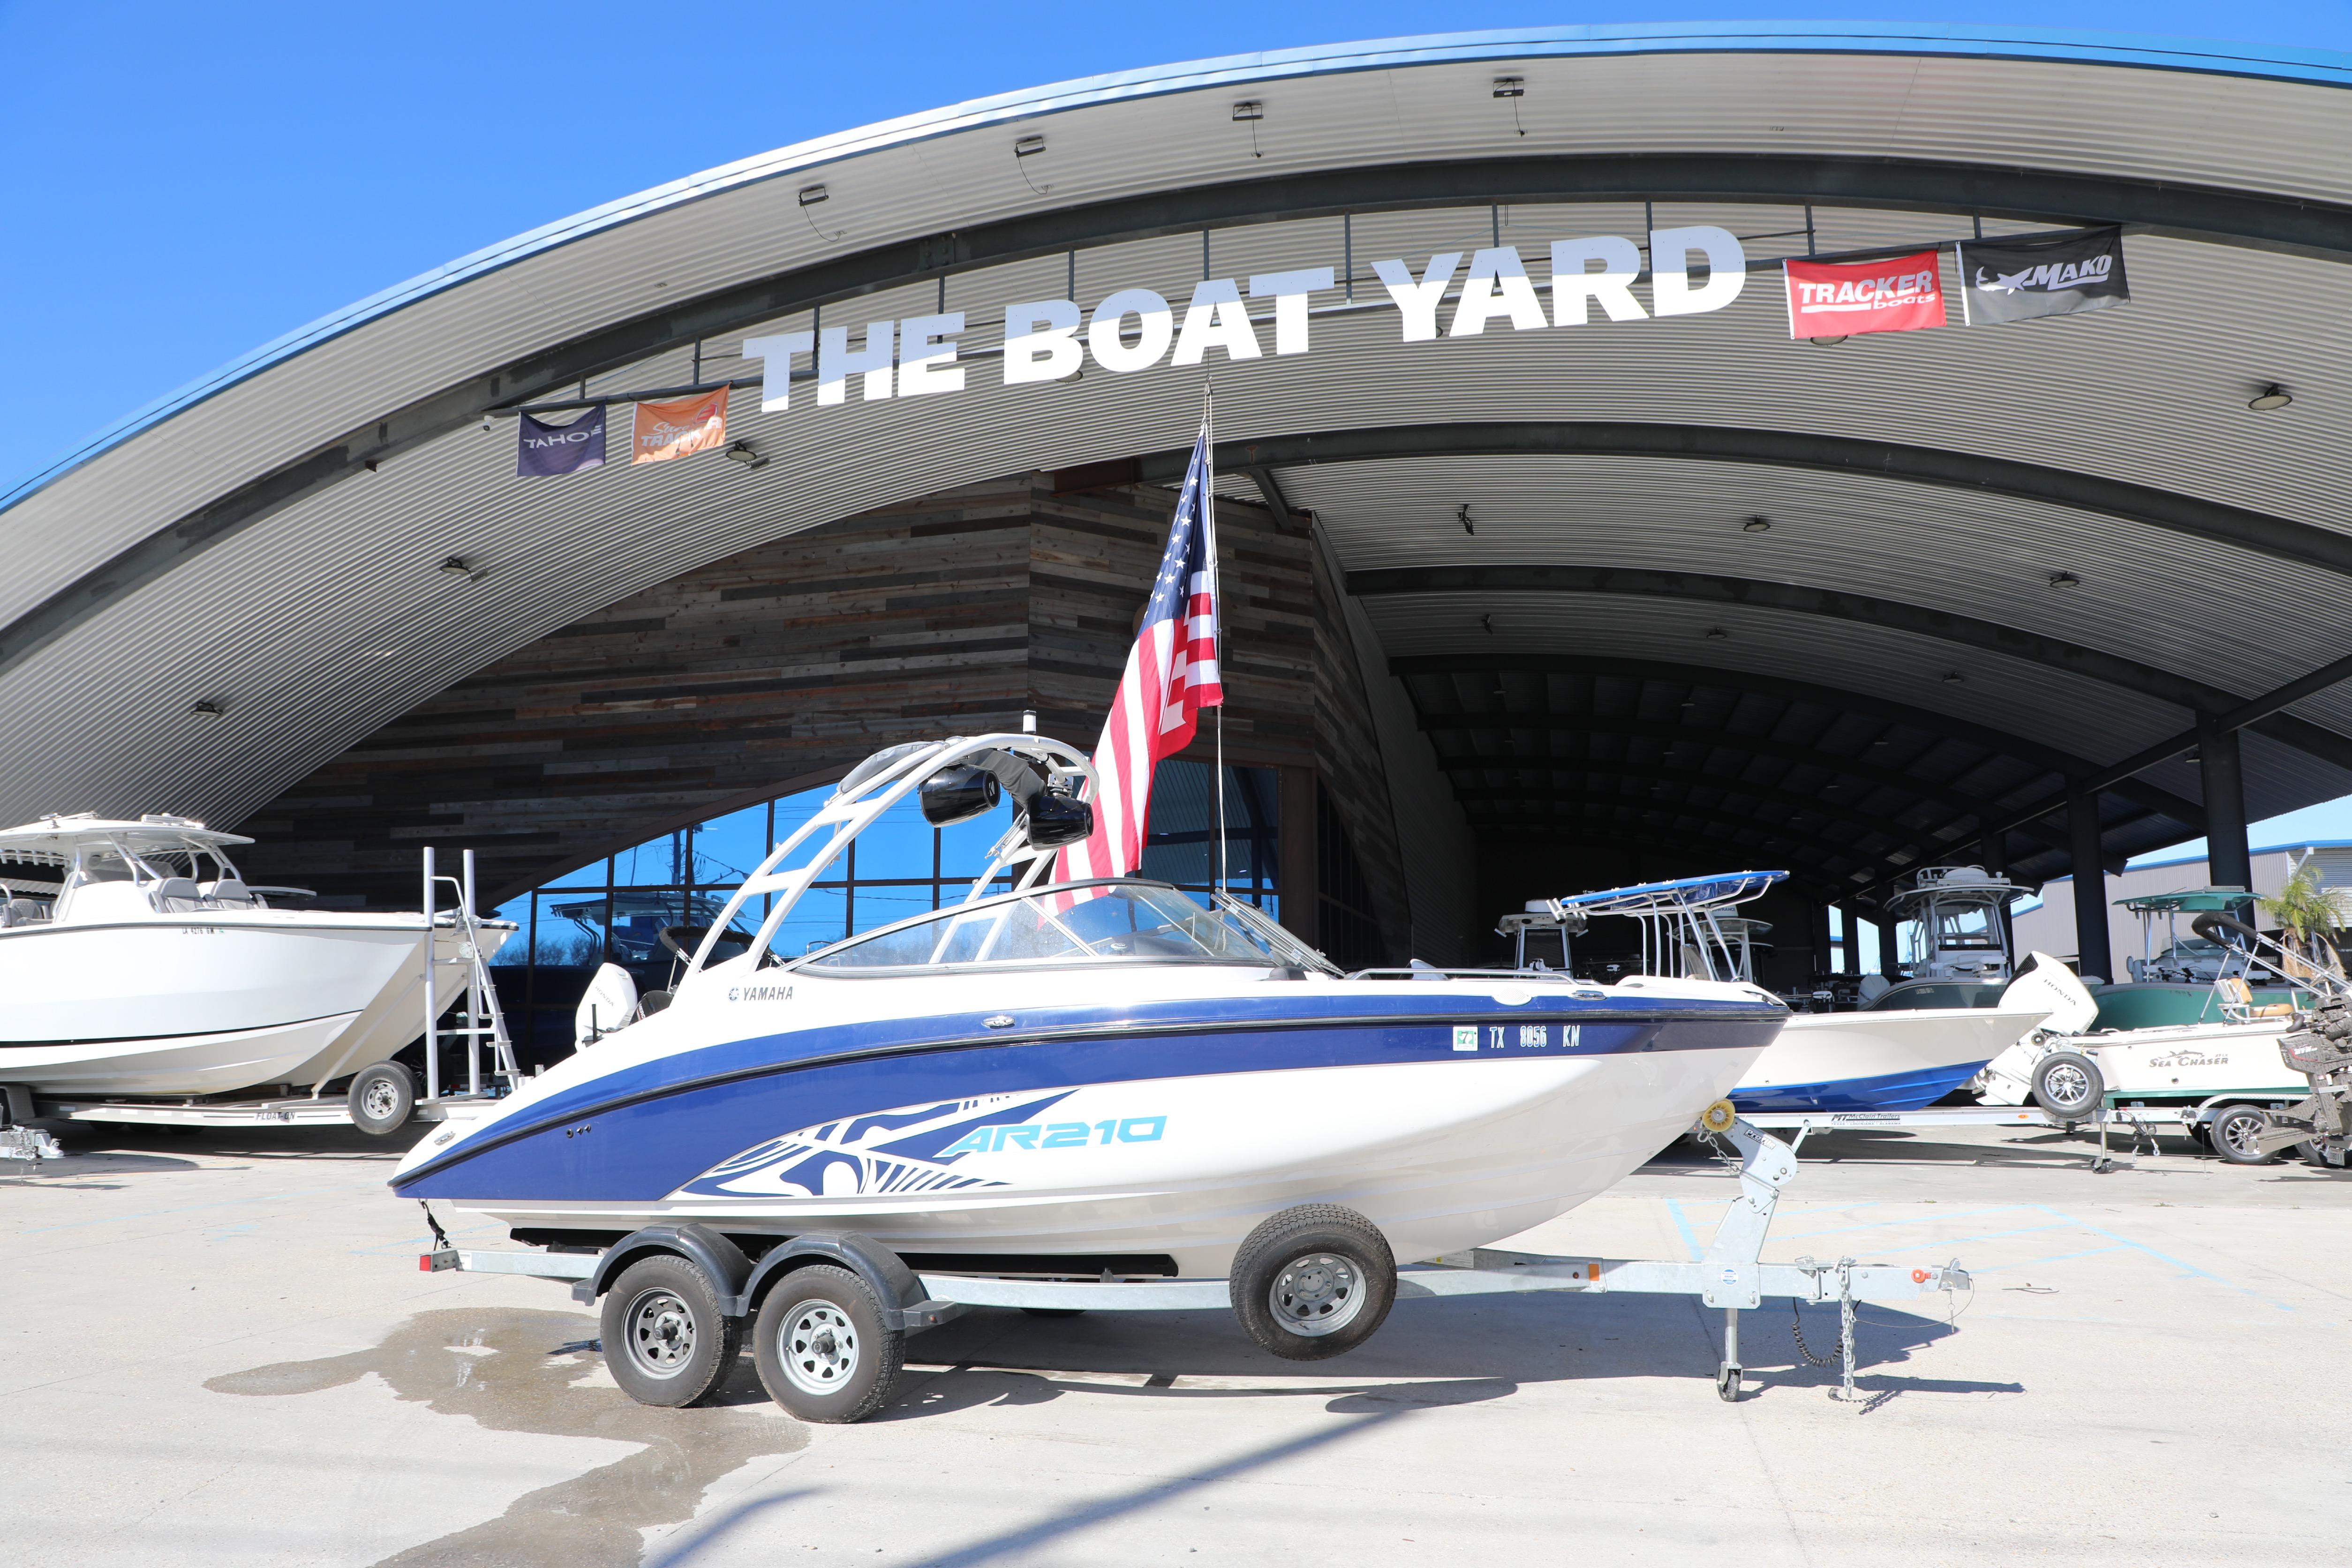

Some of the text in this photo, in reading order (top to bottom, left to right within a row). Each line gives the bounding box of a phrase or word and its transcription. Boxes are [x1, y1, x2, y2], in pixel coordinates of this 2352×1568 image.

[2023, 254, 2113, 290] MAKO
[1798, 270, 1933, 305] TRACKER
[1872, 292, 1936, 310] boats
[742, 225, 1746, 413] THE BOAT YARD
[523, 424, 602, 449] TAHOE
[595, 985, 614, 1007] HONDA
[744, 986, 793, 1001] YAMAHA
[2043, 979, 2076, 1006] HONDA
[1461, 1031, 1469, 1044] 7
[1489, 1025, 1580, 1048] TX 8056 KN
[939, 1115, 1168, 1155] AR210
